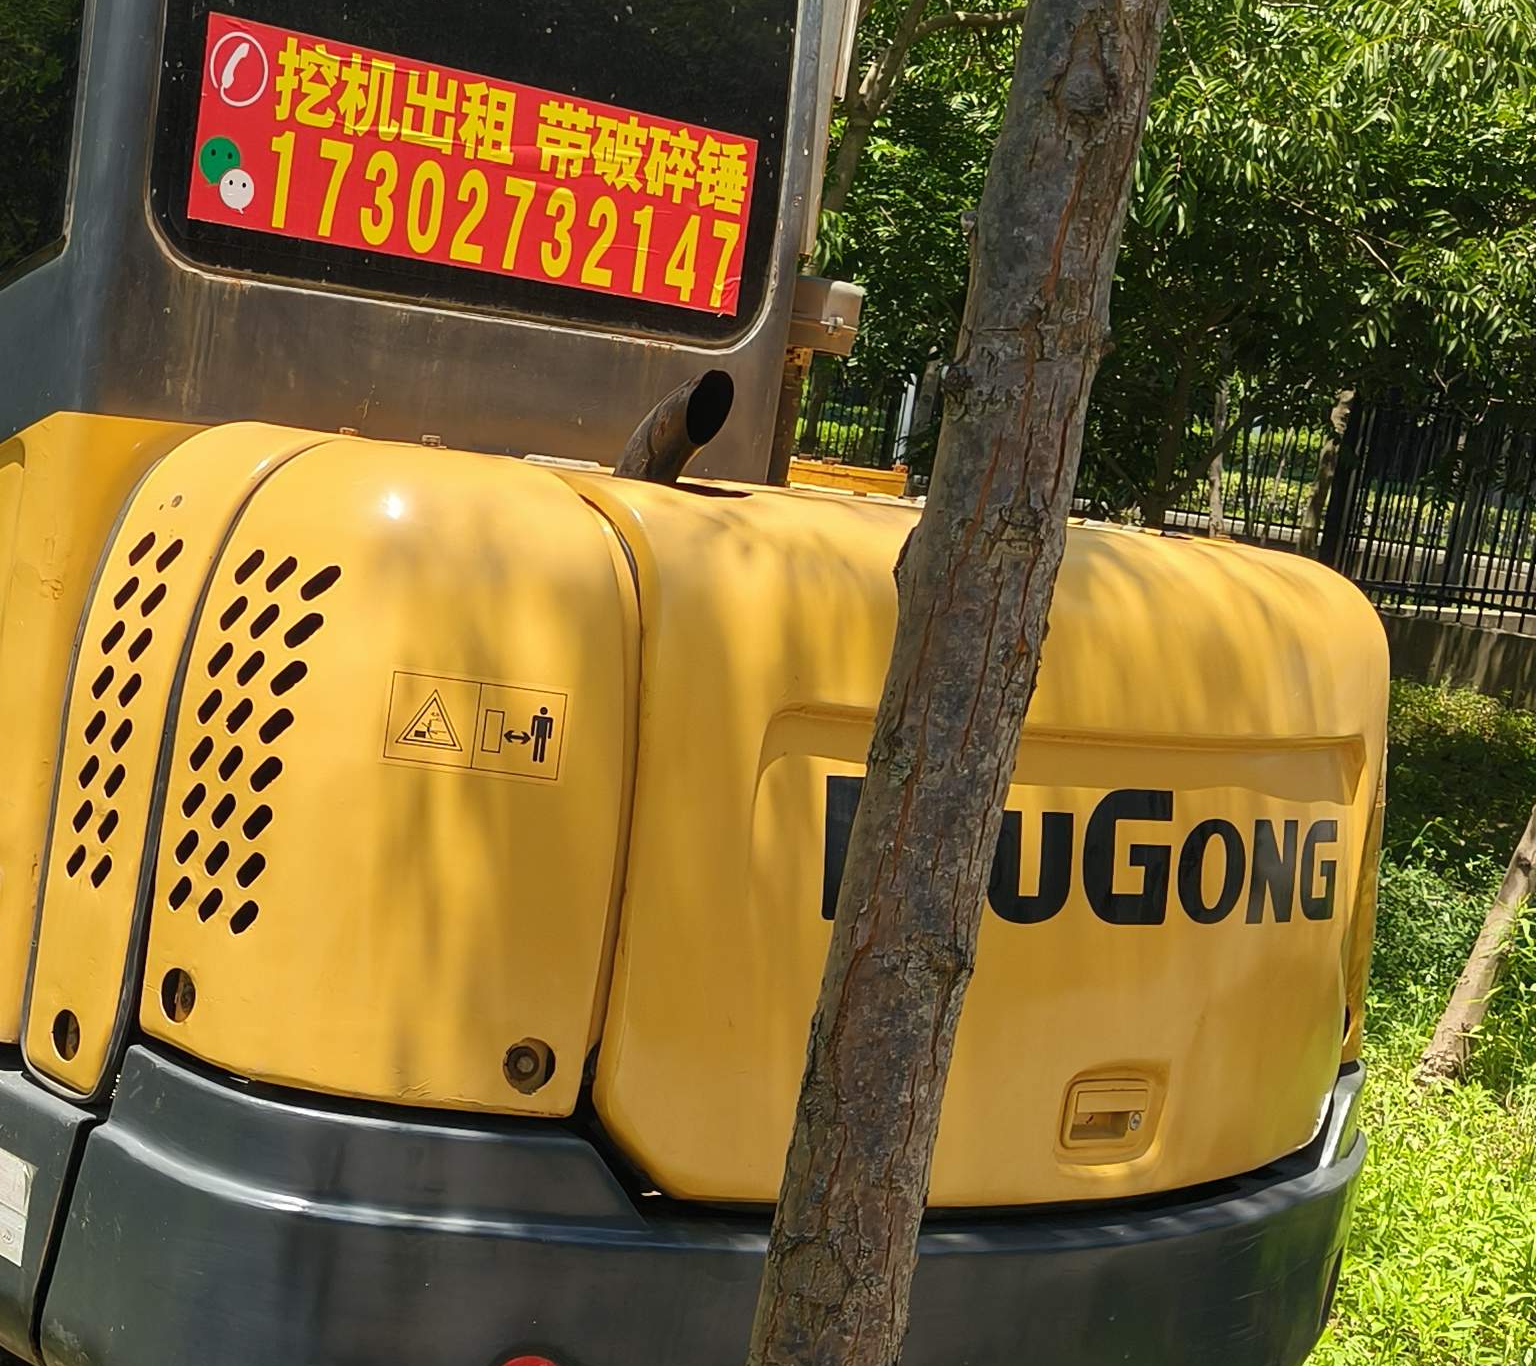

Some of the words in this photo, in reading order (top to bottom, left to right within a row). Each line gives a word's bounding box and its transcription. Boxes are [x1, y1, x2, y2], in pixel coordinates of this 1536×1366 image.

[275, 36, 517, 166] 挖机出租
[536, 100, 749, 215] 带破碎锤
[269, 131, 741, 308] 17302732147
[821, 775, 1338, 926] UGONG
